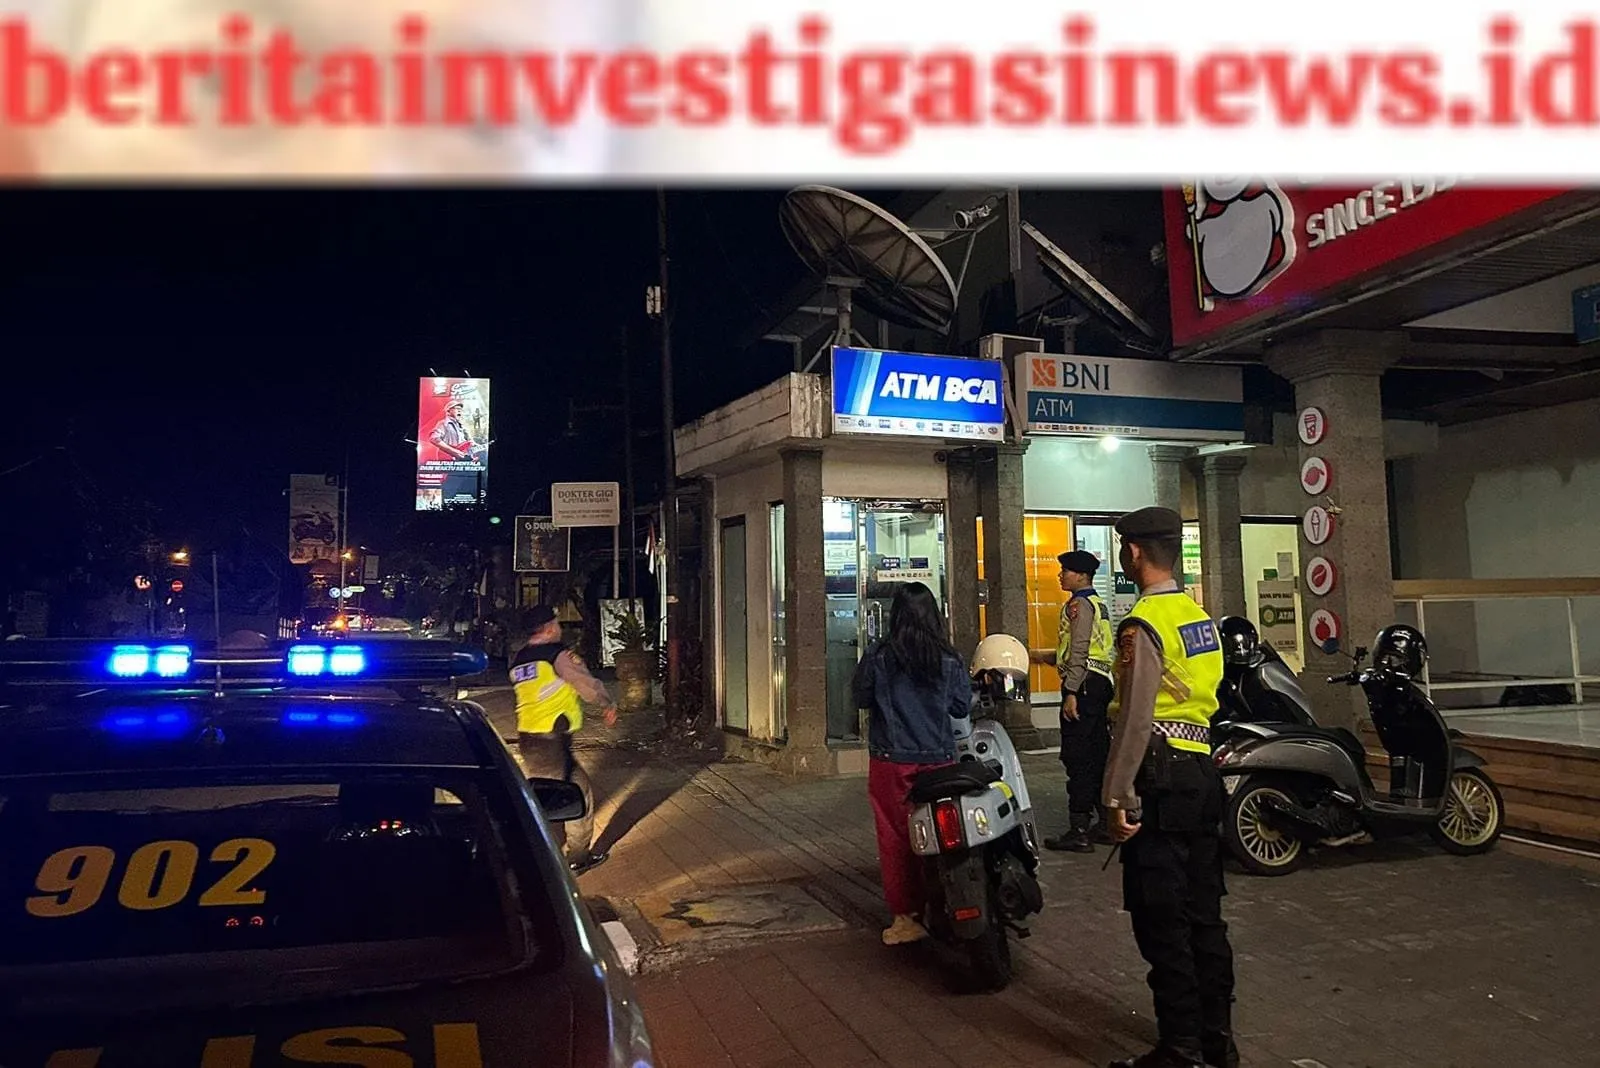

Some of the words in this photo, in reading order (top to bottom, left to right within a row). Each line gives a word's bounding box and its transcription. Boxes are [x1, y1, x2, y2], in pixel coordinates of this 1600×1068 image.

[1306, 181, 1397, 249] SINCE
[879, 372, 942, 401] ATM
[943, 377, 998, 405] BCA
[1061, 362, 1110, 391] BNI
[1034, 397, 1074, 418] ATM
[558, 490, 595, 499] DOKTER
[595, 489, 614, 498] GIGI
[1278, 611, 1294, 620] ATM
[26, 837, 277, 918] 902
